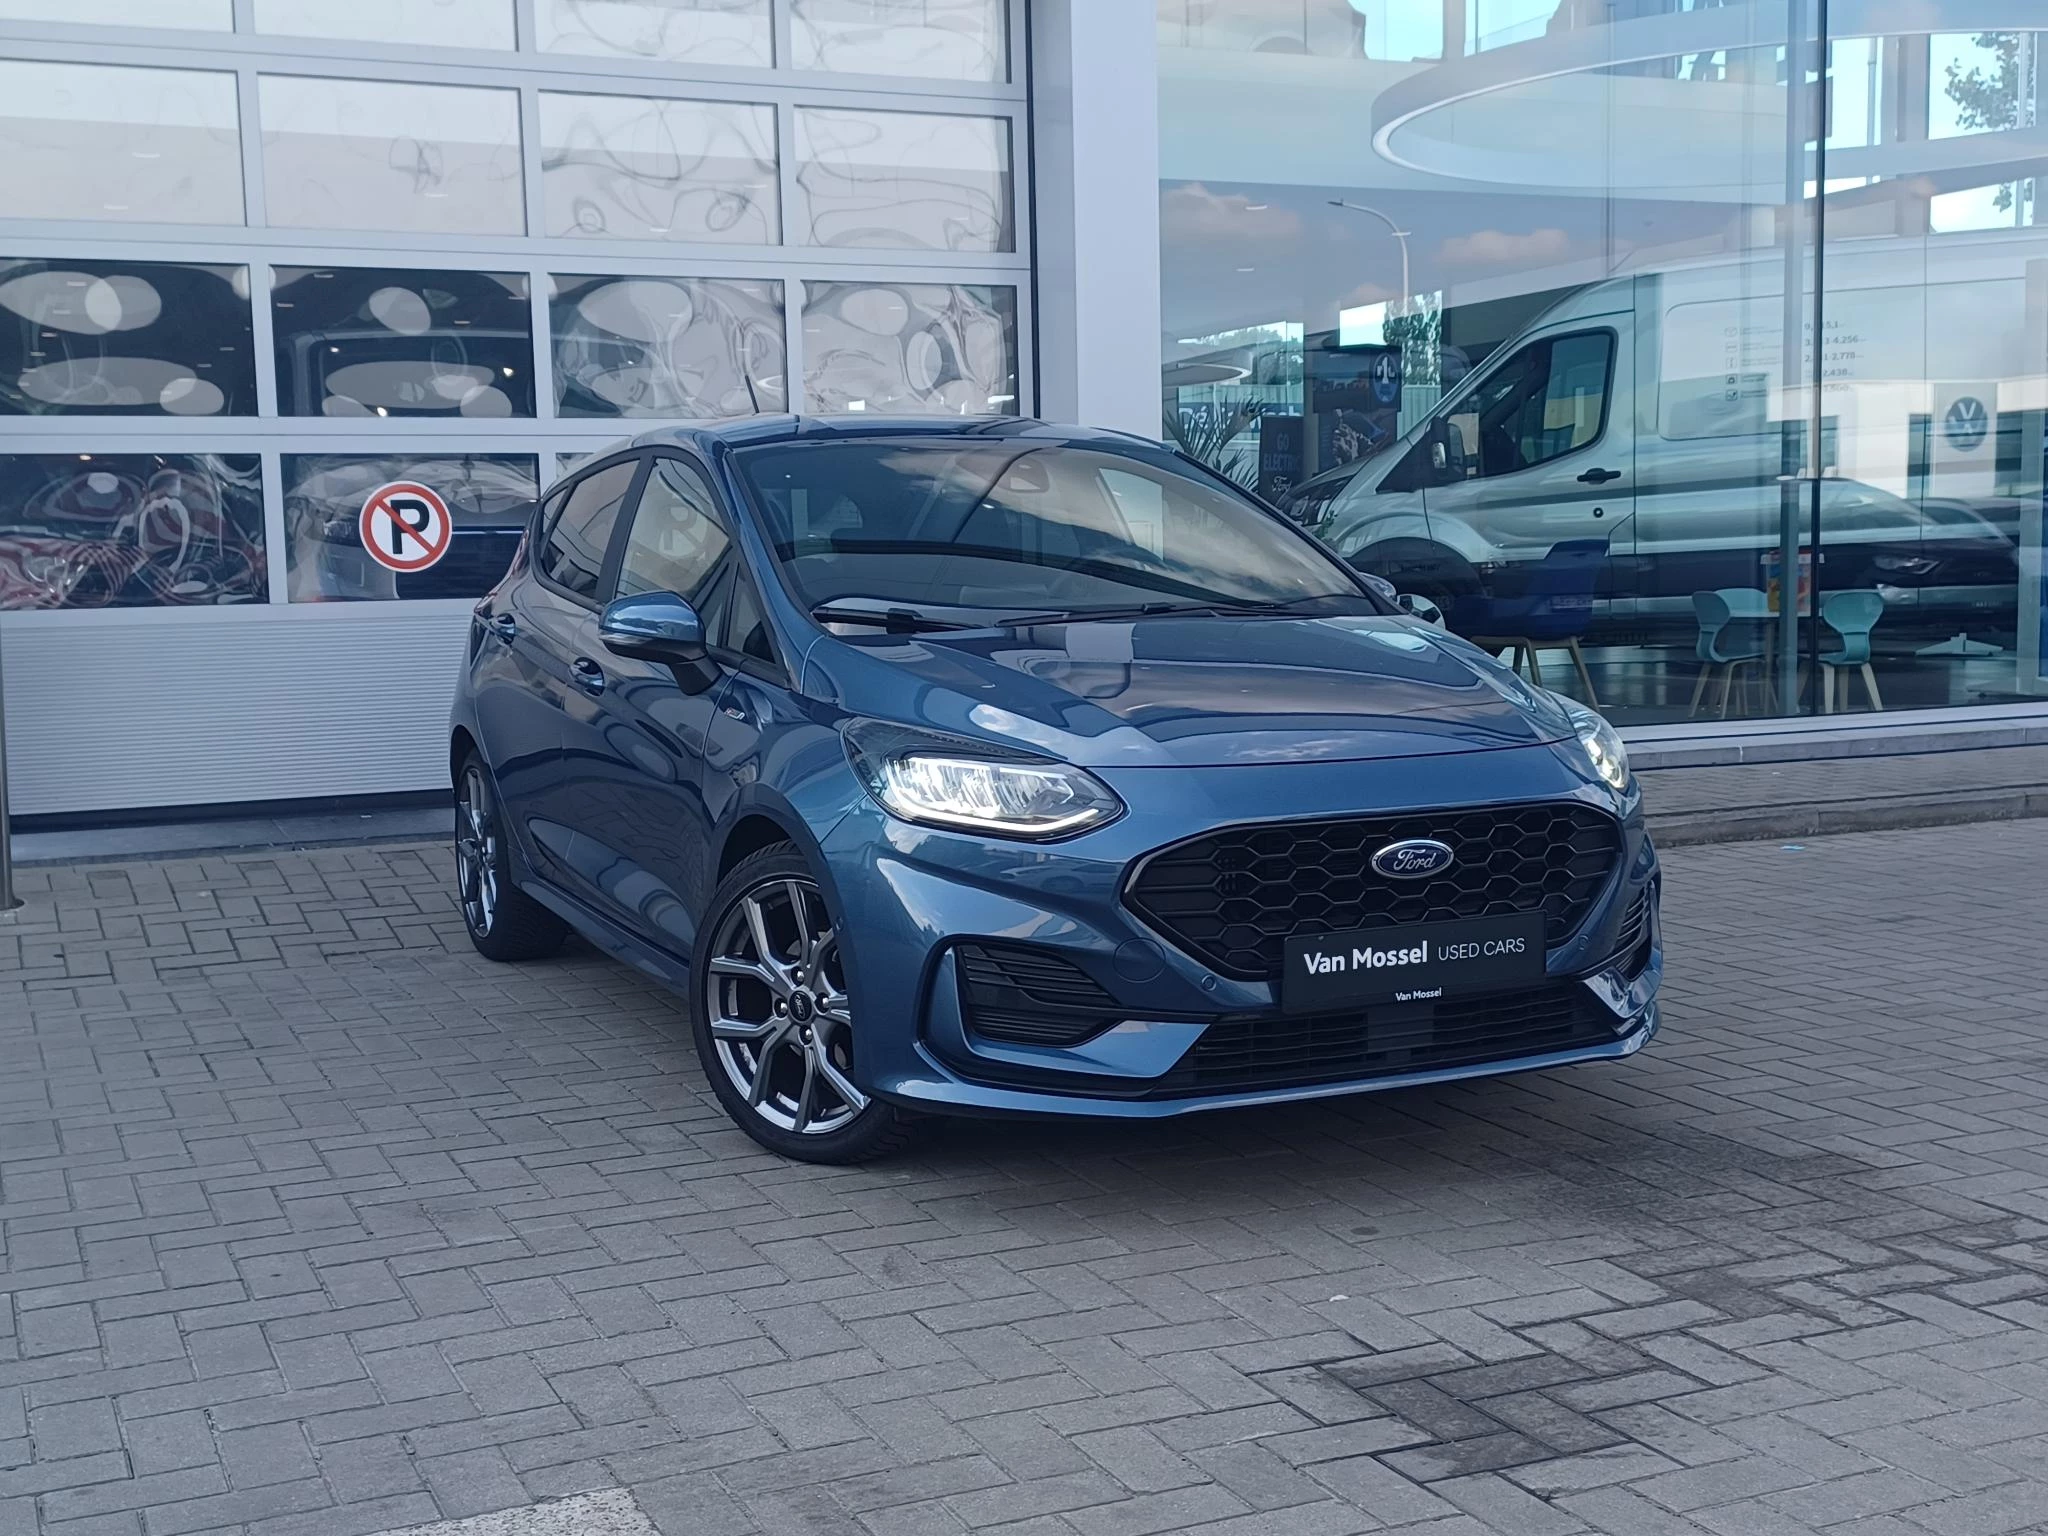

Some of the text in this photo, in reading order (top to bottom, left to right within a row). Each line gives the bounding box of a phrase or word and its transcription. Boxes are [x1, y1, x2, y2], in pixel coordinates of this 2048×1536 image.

[1393, 849, 1437, 871] Ford
[1303, 937, 1526, 975] Van Mossel USED CARS
[1395, 987, 1442, 1002] Van Mossel
